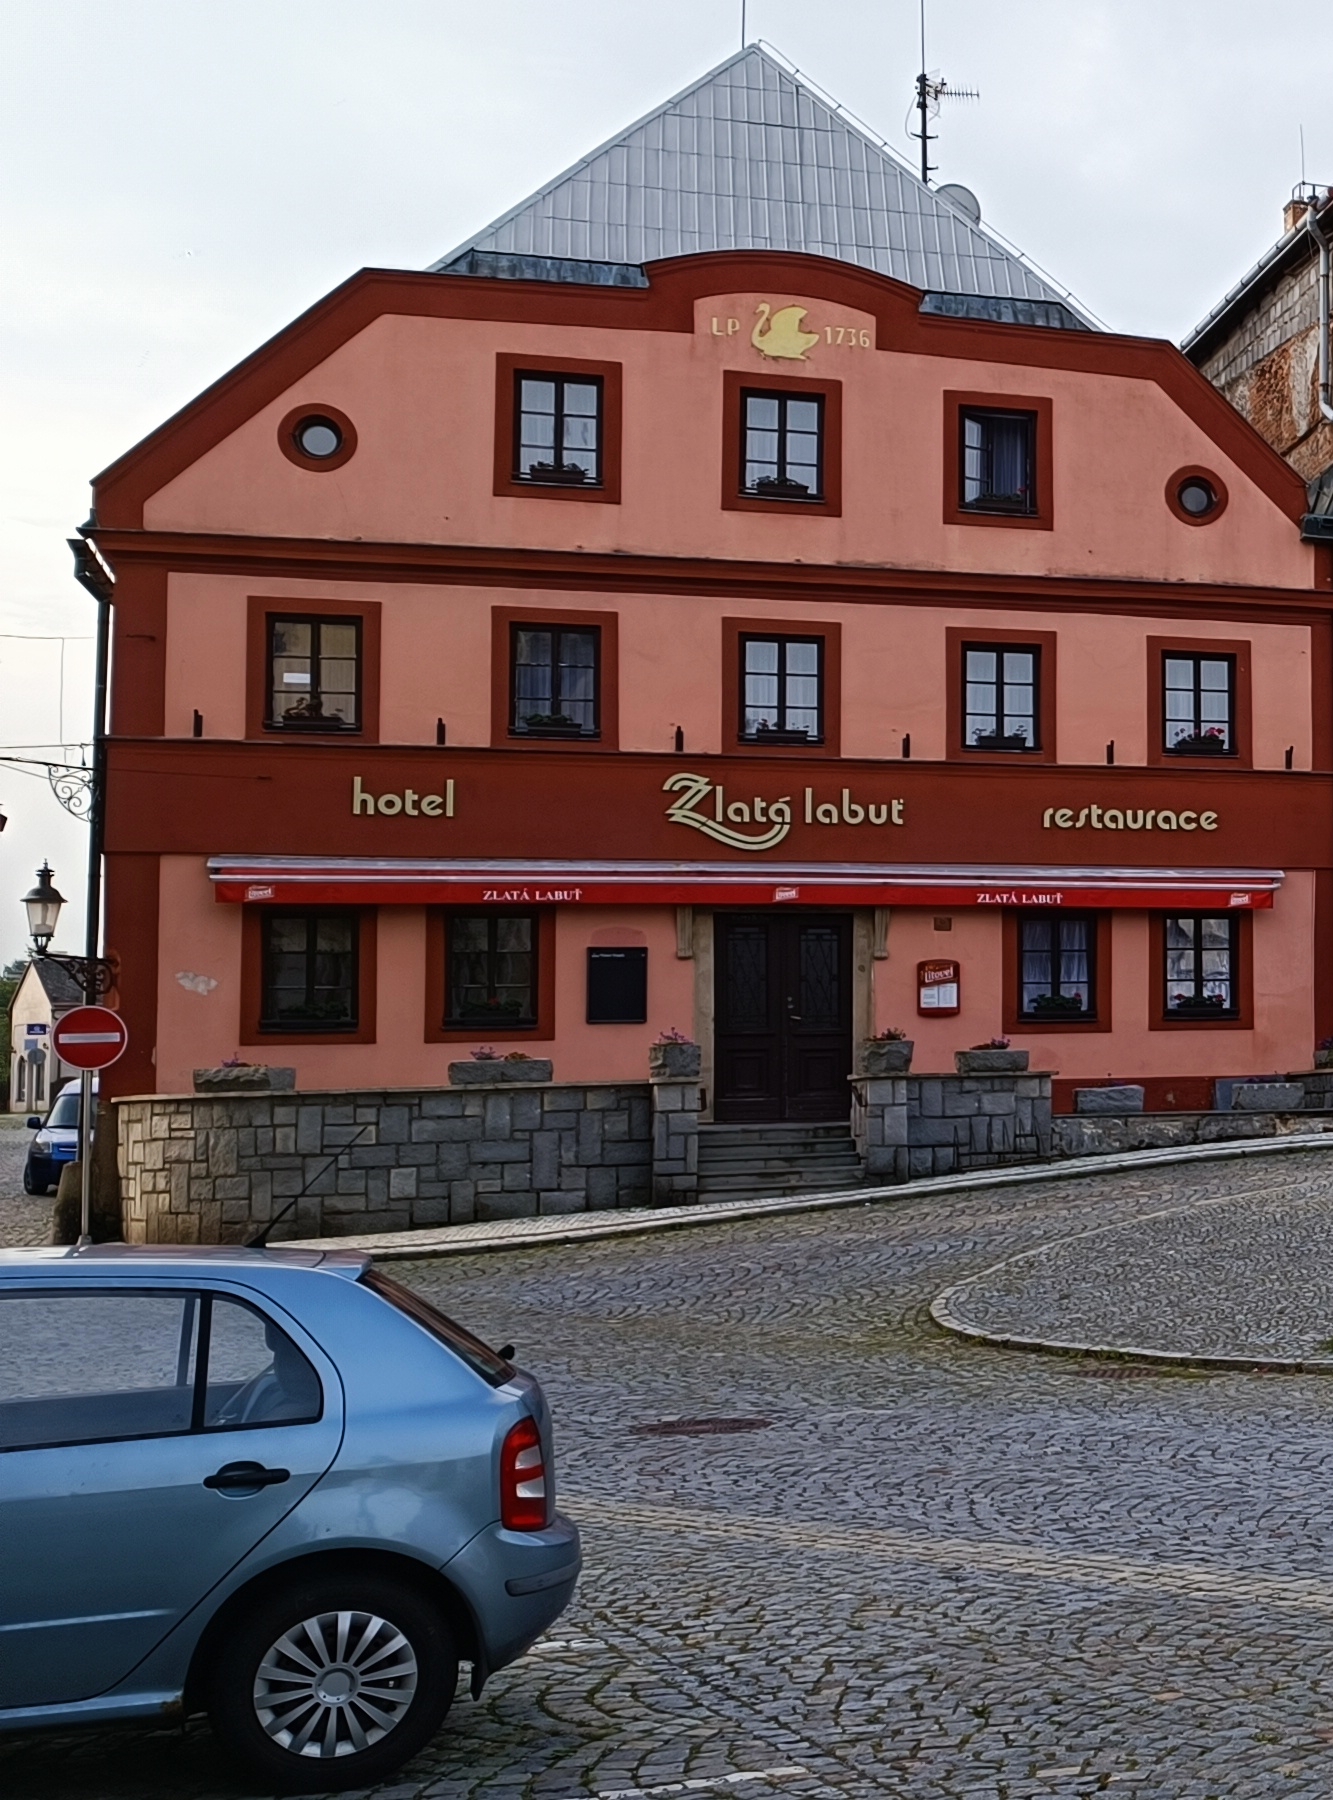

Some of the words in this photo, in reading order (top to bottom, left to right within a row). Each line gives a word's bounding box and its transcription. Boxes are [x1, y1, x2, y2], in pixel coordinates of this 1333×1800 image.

[711, 317, 740, 336] LP
[824, 326, 870, 348] 1736
[353, 776, 454, 817] hotel
[662, 772, 791, 850] Zlatá
[805, 787, 904, 824] labuť
[1043, 804, 1218, 831] restaurace
[483, 887, 530, 901] ZLATÁ
[535, 888, 583, 901] LABUŤ
[976, 891, 1018, 904] ZLATÁ
